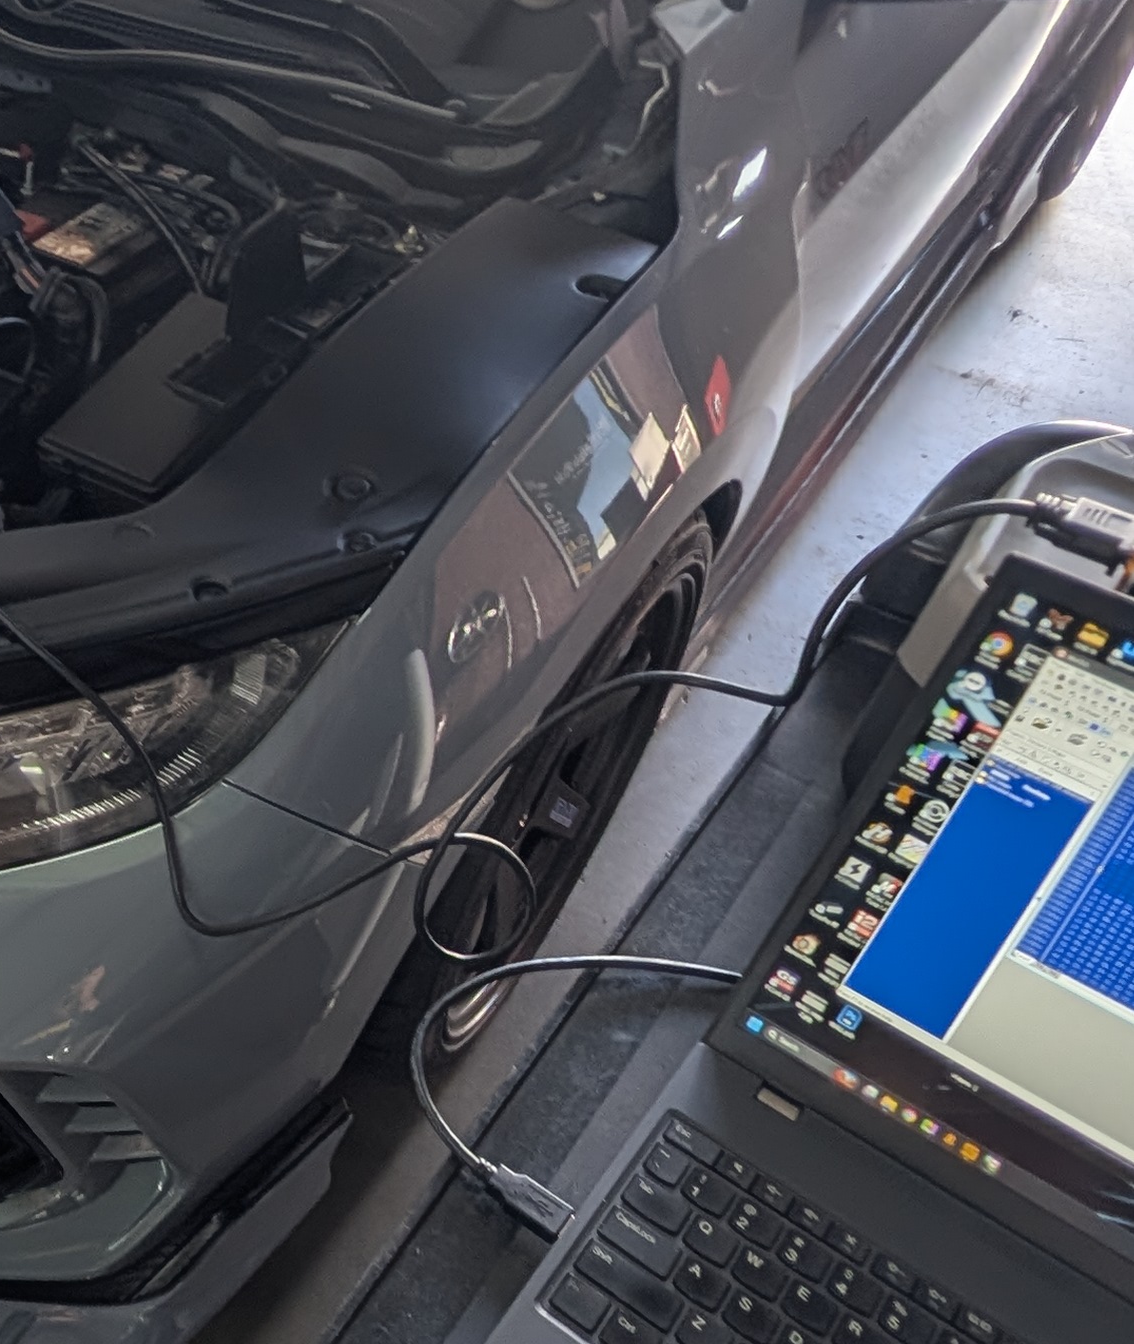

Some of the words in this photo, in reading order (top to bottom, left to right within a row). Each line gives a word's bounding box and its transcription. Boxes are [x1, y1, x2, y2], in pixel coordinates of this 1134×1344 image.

[698, 1220, 713, 1235] Q
[735, 1215, 750, 1231] 2
[746, 1250, 764, 1268] W
[688, 1264, 701, 1278] A
[796, 1285, 811, 1302] E
[738, 1296, 753, 1312] S
[691, 1314, 707, 1331] Z
[848, 1319, 863, 1337] R
